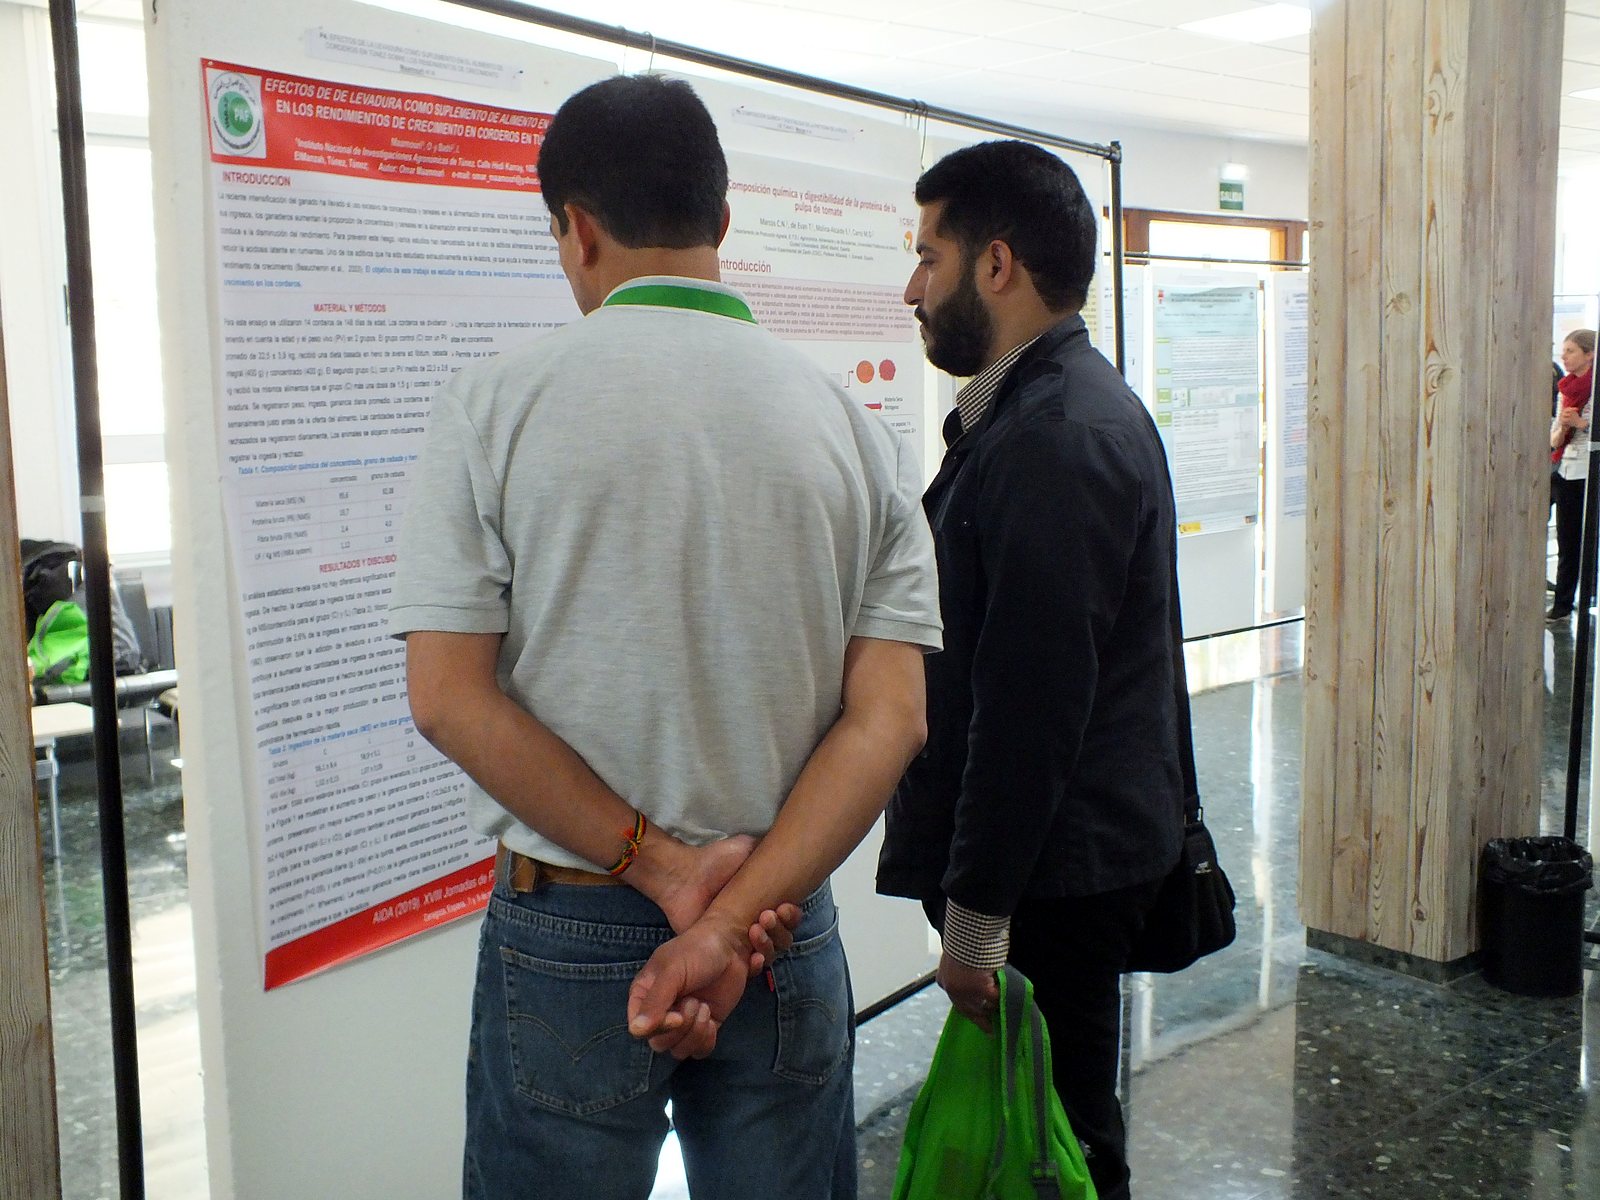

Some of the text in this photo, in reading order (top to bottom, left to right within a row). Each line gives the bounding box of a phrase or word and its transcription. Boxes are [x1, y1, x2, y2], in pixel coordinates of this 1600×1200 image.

[264, 77, 315, 98] EFECTOS
[316, 86, 333, 100] DE
[333, 88, 349, 103] DE
[349, 91, 402, 111] LEVADURA
[403, 98, 434, 115] COMO
[434, 103, 488, 122] SUPLEMENTO
[487, 110, 501, 123] DE
[500, 113, 539, 128] ALIMENTO
[275, 98, 291, 114] EN
[291, 101, 314, 117] LOS
[315, 104, 390, 128] RENDIMIENTOS
[391, 115, 406, 129] DE
[465, 125, 477, 138] EN
[477, 127, 521, 144] CORDEROS
[520, 132, 532, 145] EN
[720, 258, 772, 274] ntroducción
[313, 303, 347, 312] MATERIAL
[318, 558, 361, 574] RESULTADOS
[367, 553, 398, 567] DISCUSIÓ
